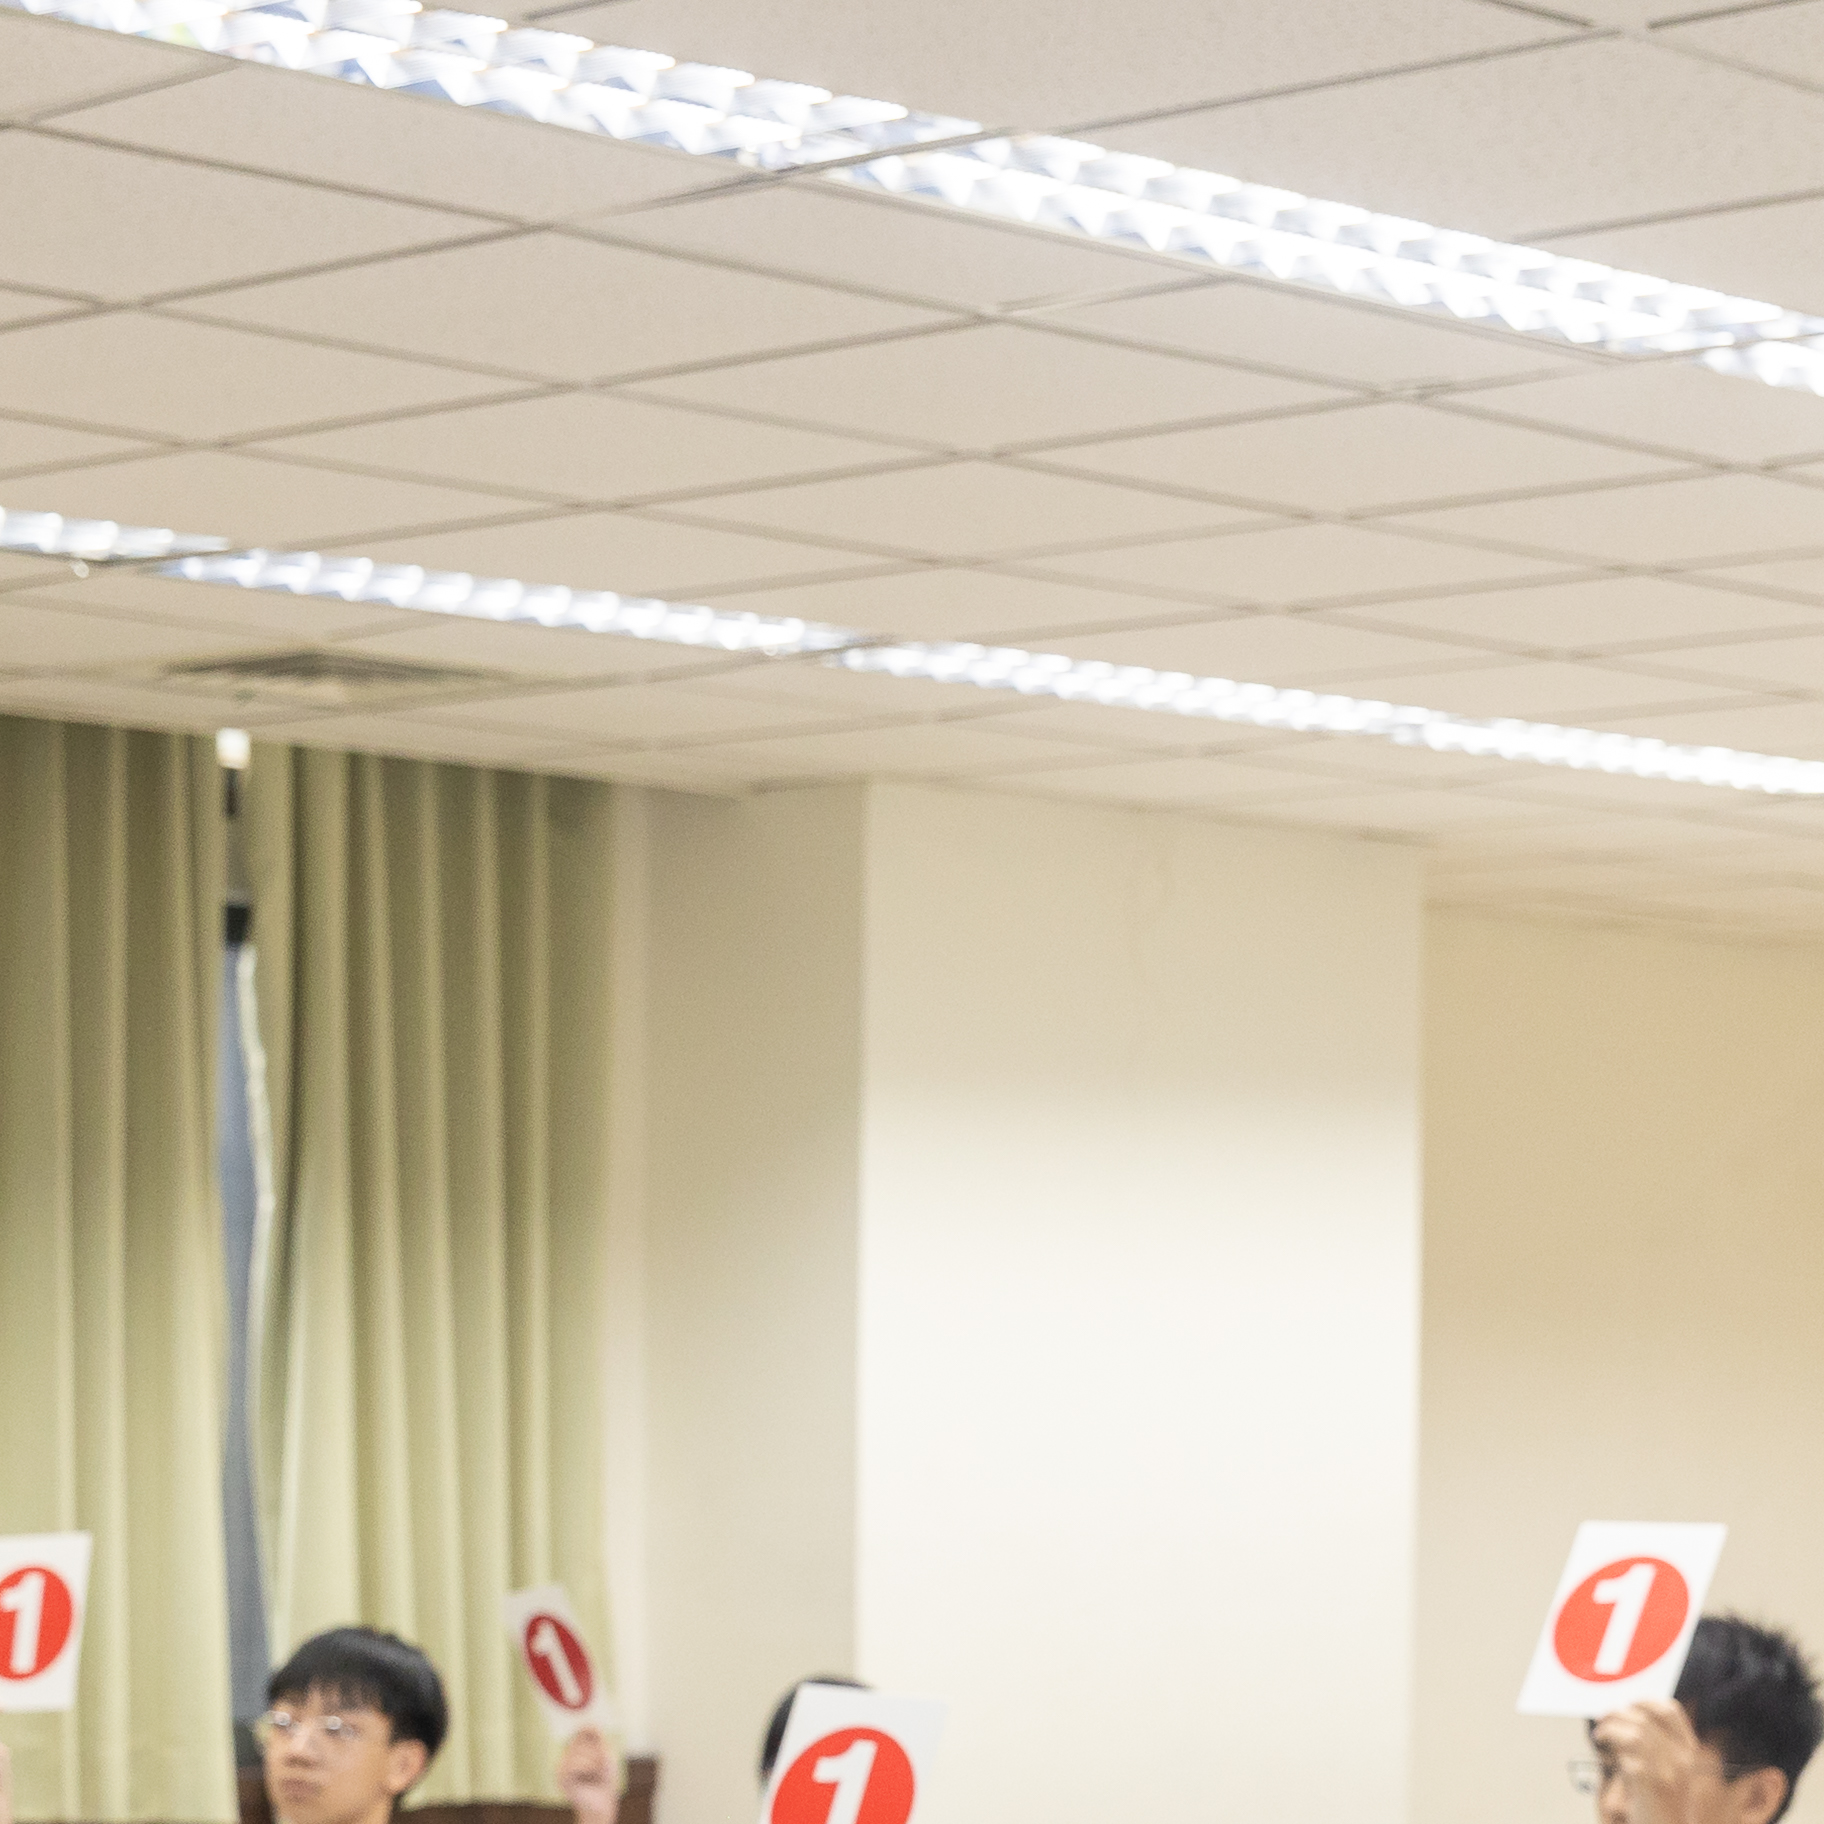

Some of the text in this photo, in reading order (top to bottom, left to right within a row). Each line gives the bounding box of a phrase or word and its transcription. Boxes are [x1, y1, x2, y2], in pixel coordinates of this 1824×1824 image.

[0, 1571, 45, 1674] 1
[532, 1619, 583, 1704] 1
[1593, 1563, 1656, 1675] 1
